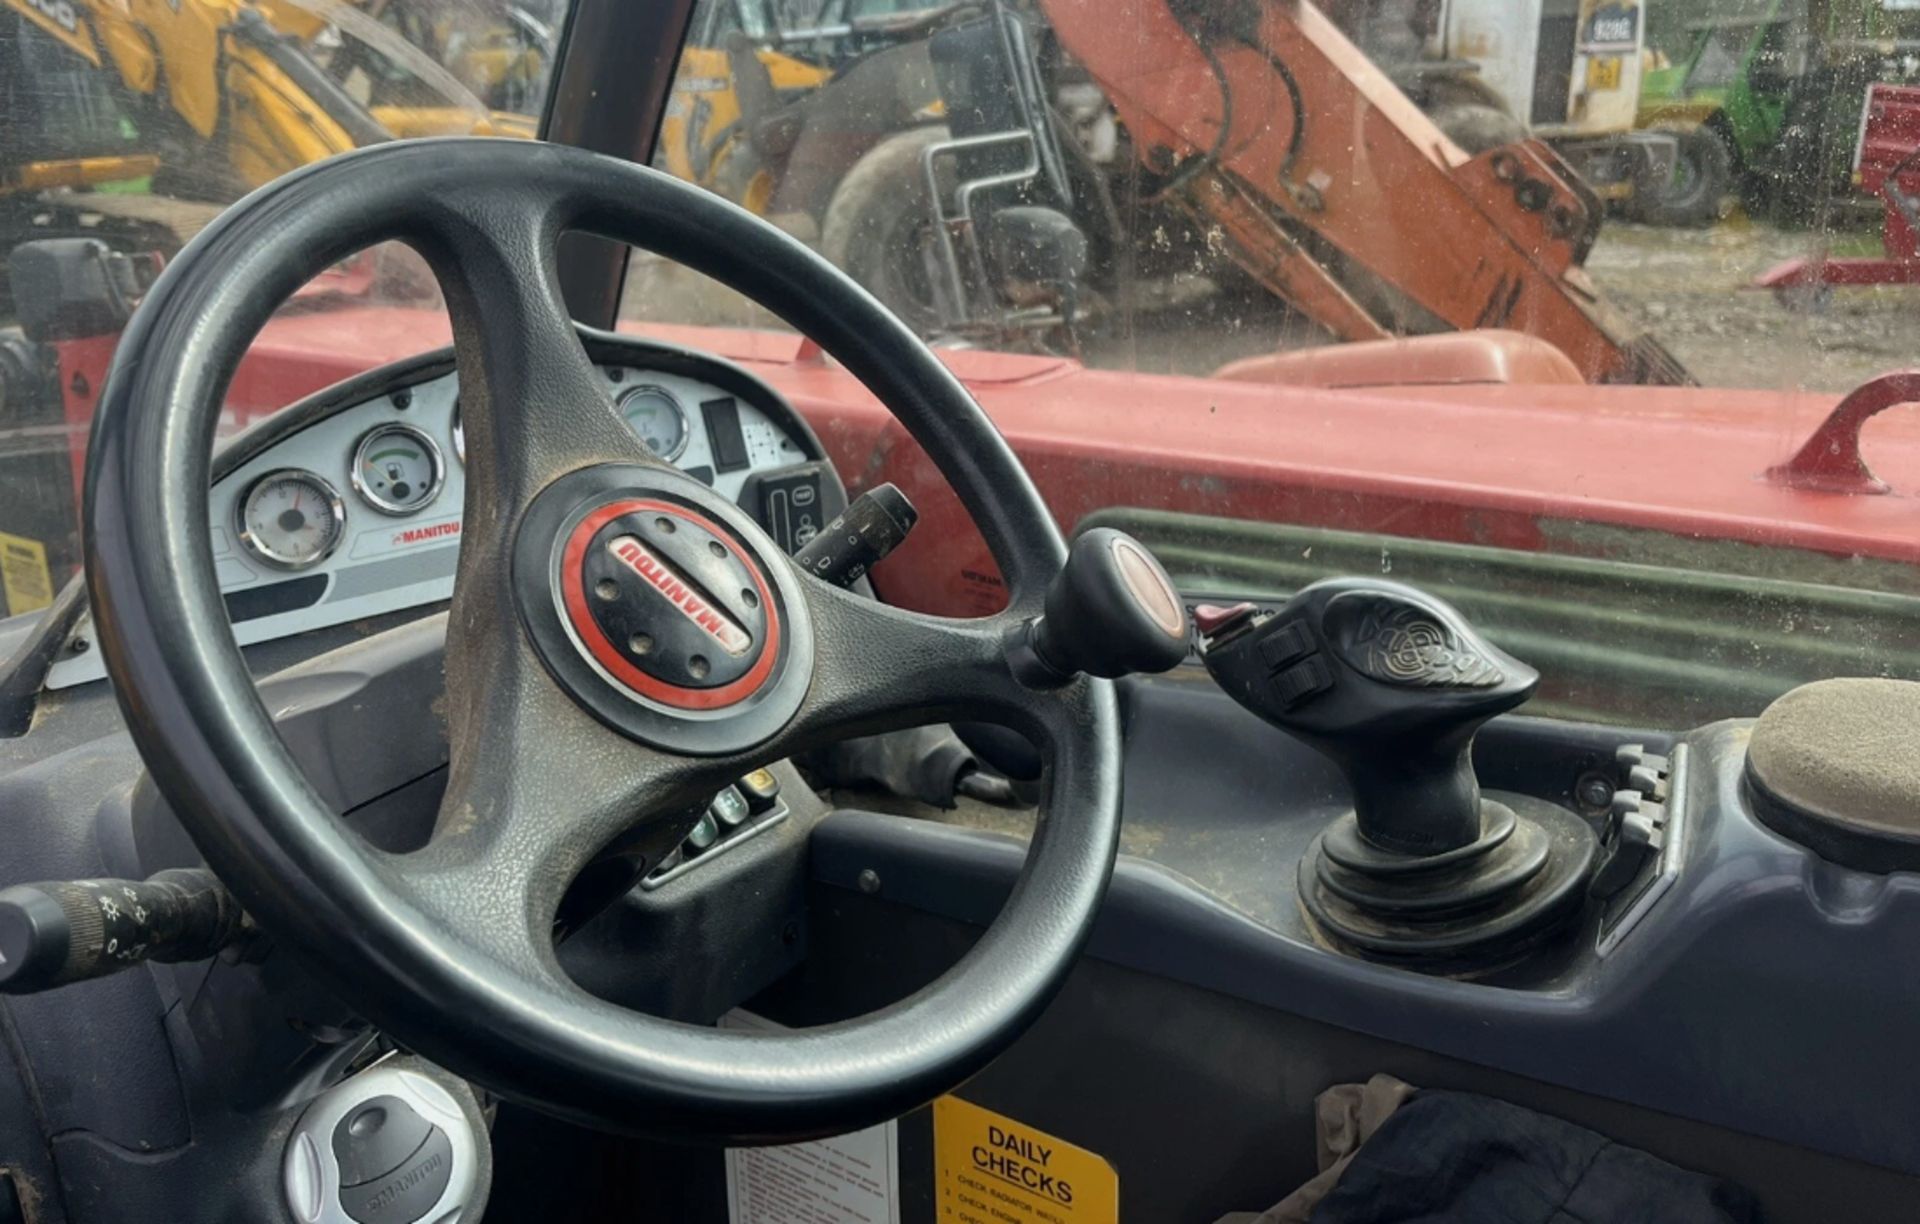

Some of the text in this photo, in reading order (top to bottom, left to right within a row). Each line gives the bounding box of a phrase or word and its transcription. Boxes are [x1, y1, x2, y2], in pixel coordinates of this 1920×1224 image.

[403, 522, 460, 543] MANITOU
[618, 542, 724, 633] MANITOU
[988, 1125, 1052, 1167] DAILY
[957, 1174, 987, 1194] CHECK
[990, 1188, 1033, 1213] RADIATOR
[972, 1145, 1073, 1204] CHECKS
[958, 1193, 988, 1213] CHECK
